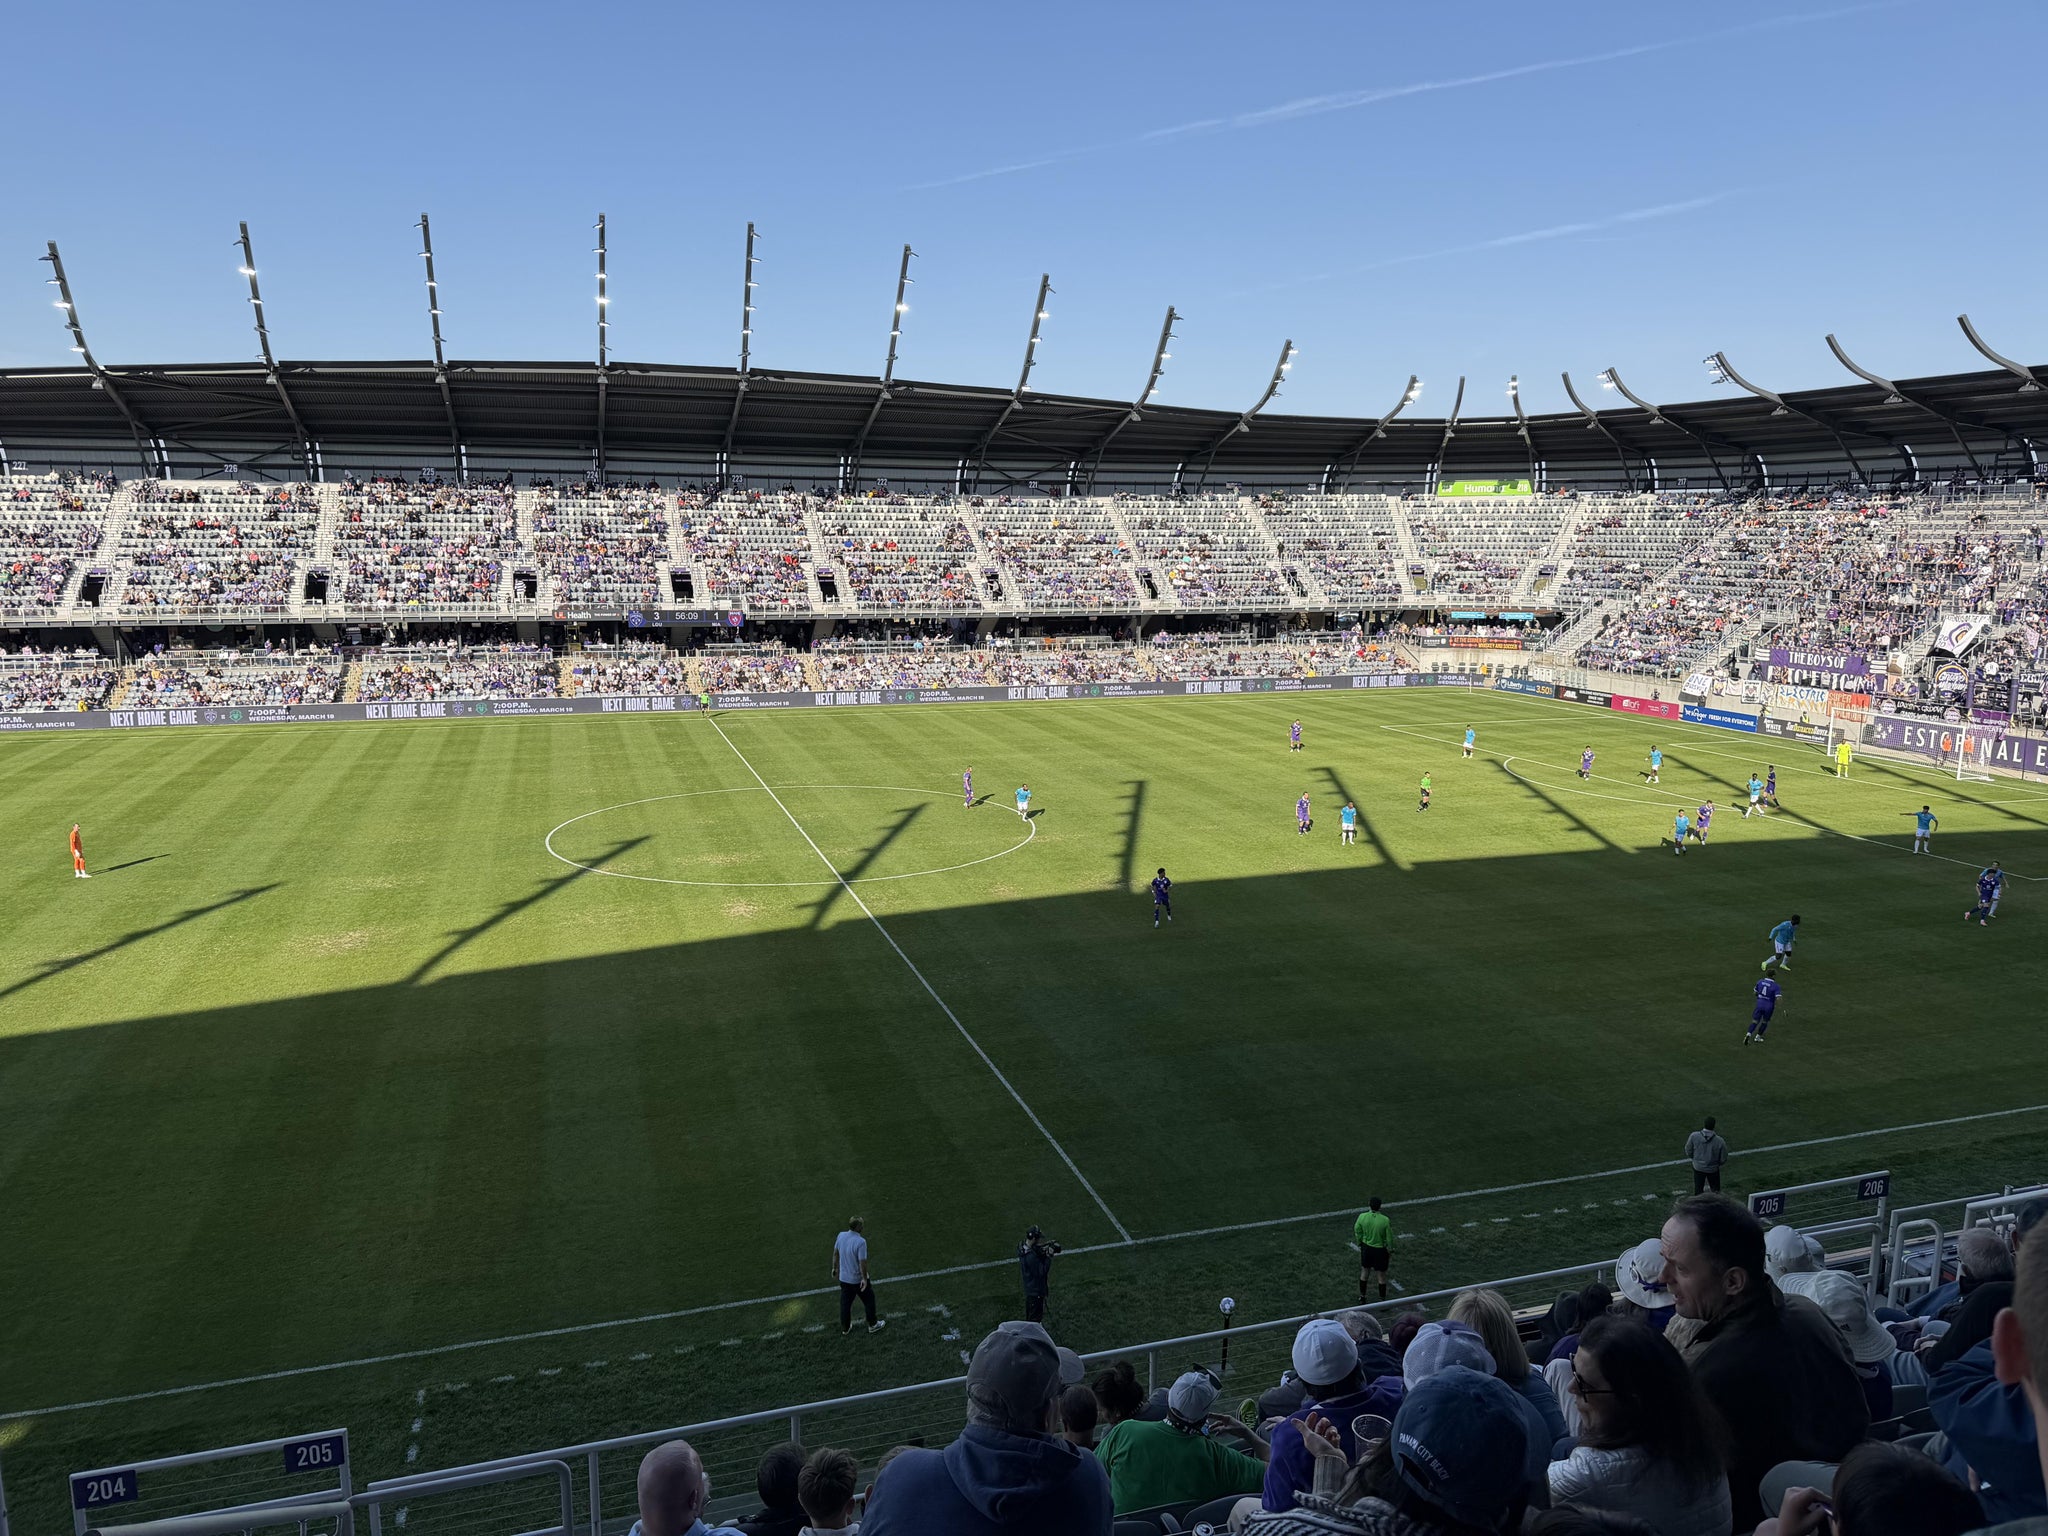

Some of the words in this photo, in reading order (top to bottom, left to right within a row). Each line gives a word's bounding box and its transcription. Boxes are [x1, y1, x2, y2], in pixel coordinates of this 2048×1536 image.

[12, 461, 27, 470] 227
[224, 464, 238, 473] 226
[422, 467, 435, 476] 225
[731, 474, 743, 483] 223
[554, 611, 567, 619] UL
[567, 611, 592, 619] Health
[654, 612, 660, 621] 3
[675, 612, 699, 621] 56:09
[714, 612, 719, 621] 1
[1788, 651, 1807, 664] THE
[1807, 653, 1834, 668] BOYS
[1833, 656, 1848, 669] OF
[1186, 682, 1202, 694] NEXT
[1203, 681, 1221, 693] HOME
[1224, 680, 1243, 692] GAME
[1353, 677, 1369, 688] NEXT
[1369, 676, 1388, 687] HOME
[1388, 675, 1407, 687] GAME
[815, 693, 835, 706] NEXT
[836, 692, 858, 705] HOME
[860, 691, 882, 704] GAME
[1008, 687, 1025, 700] NEXT
[1027, 686, 1046, 699] HOME
[1049, 685, 1069, 698] GAME
[1779, 686, 1826, 702] ELECTRIC
[1829, 692, 1852, 703] SUPER
[602, 698, 623, 711] NEXT
[625, 697, 650, 711] HOME
[652, 696, 676, 710] GAME
[366, 705, 388, 719] NEXT
[391, 703, 420, 718] HOME
[420, 702, 447, 717] GAME
[1691, 708, 1707, 721] Kroger
[110, 712, 135, 726] NEXT
[137, 711, 167, 725] HOME
[169, 710, 198, 724] GAME
[1731, 718, 1755, 727] EVERYONE.
[1762, 986, 1767, 996] 4
[1863, 1180, 1884, 1196] 206
[1759, 1197, 1779, 1215] 205
[296, 1443, 333, 1467] 205
[1399, 1433, 1419, 1450] PANAMA
[1416, 1445, 1433, 1462] CITY
[1430, 1458, 1450, 1480] BEACH
[86, 1477, 126, 1503] 204
